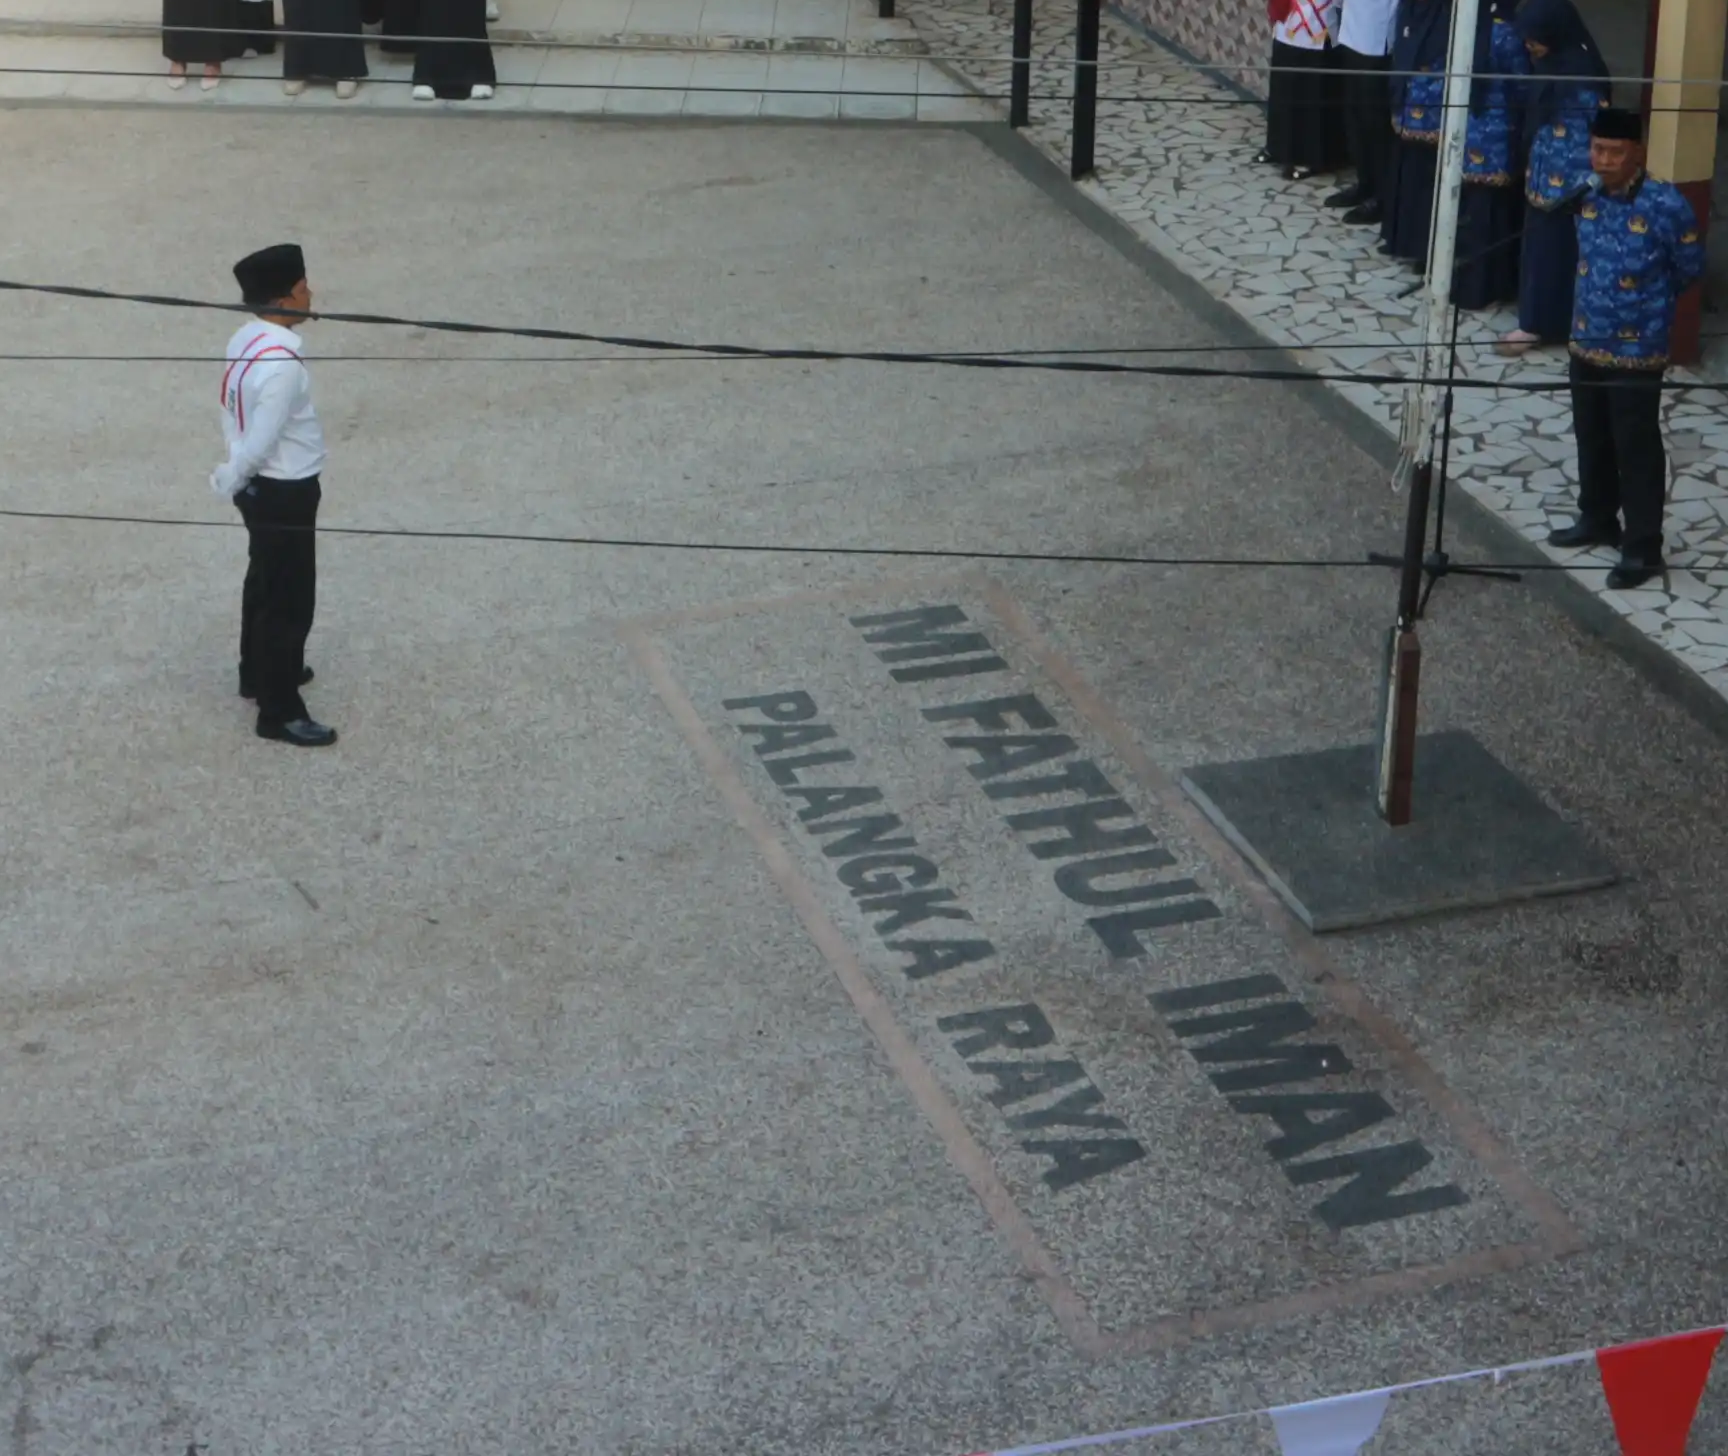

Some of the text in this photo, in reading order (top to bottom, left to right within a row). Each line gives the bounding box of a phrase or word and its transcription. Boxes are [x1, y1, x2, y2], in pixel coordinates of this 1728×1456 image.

[722, 690, 1147, 1193] PALANGKA RAYA
[849, 604, 1471, 1231] MI FATHUL IMAN
